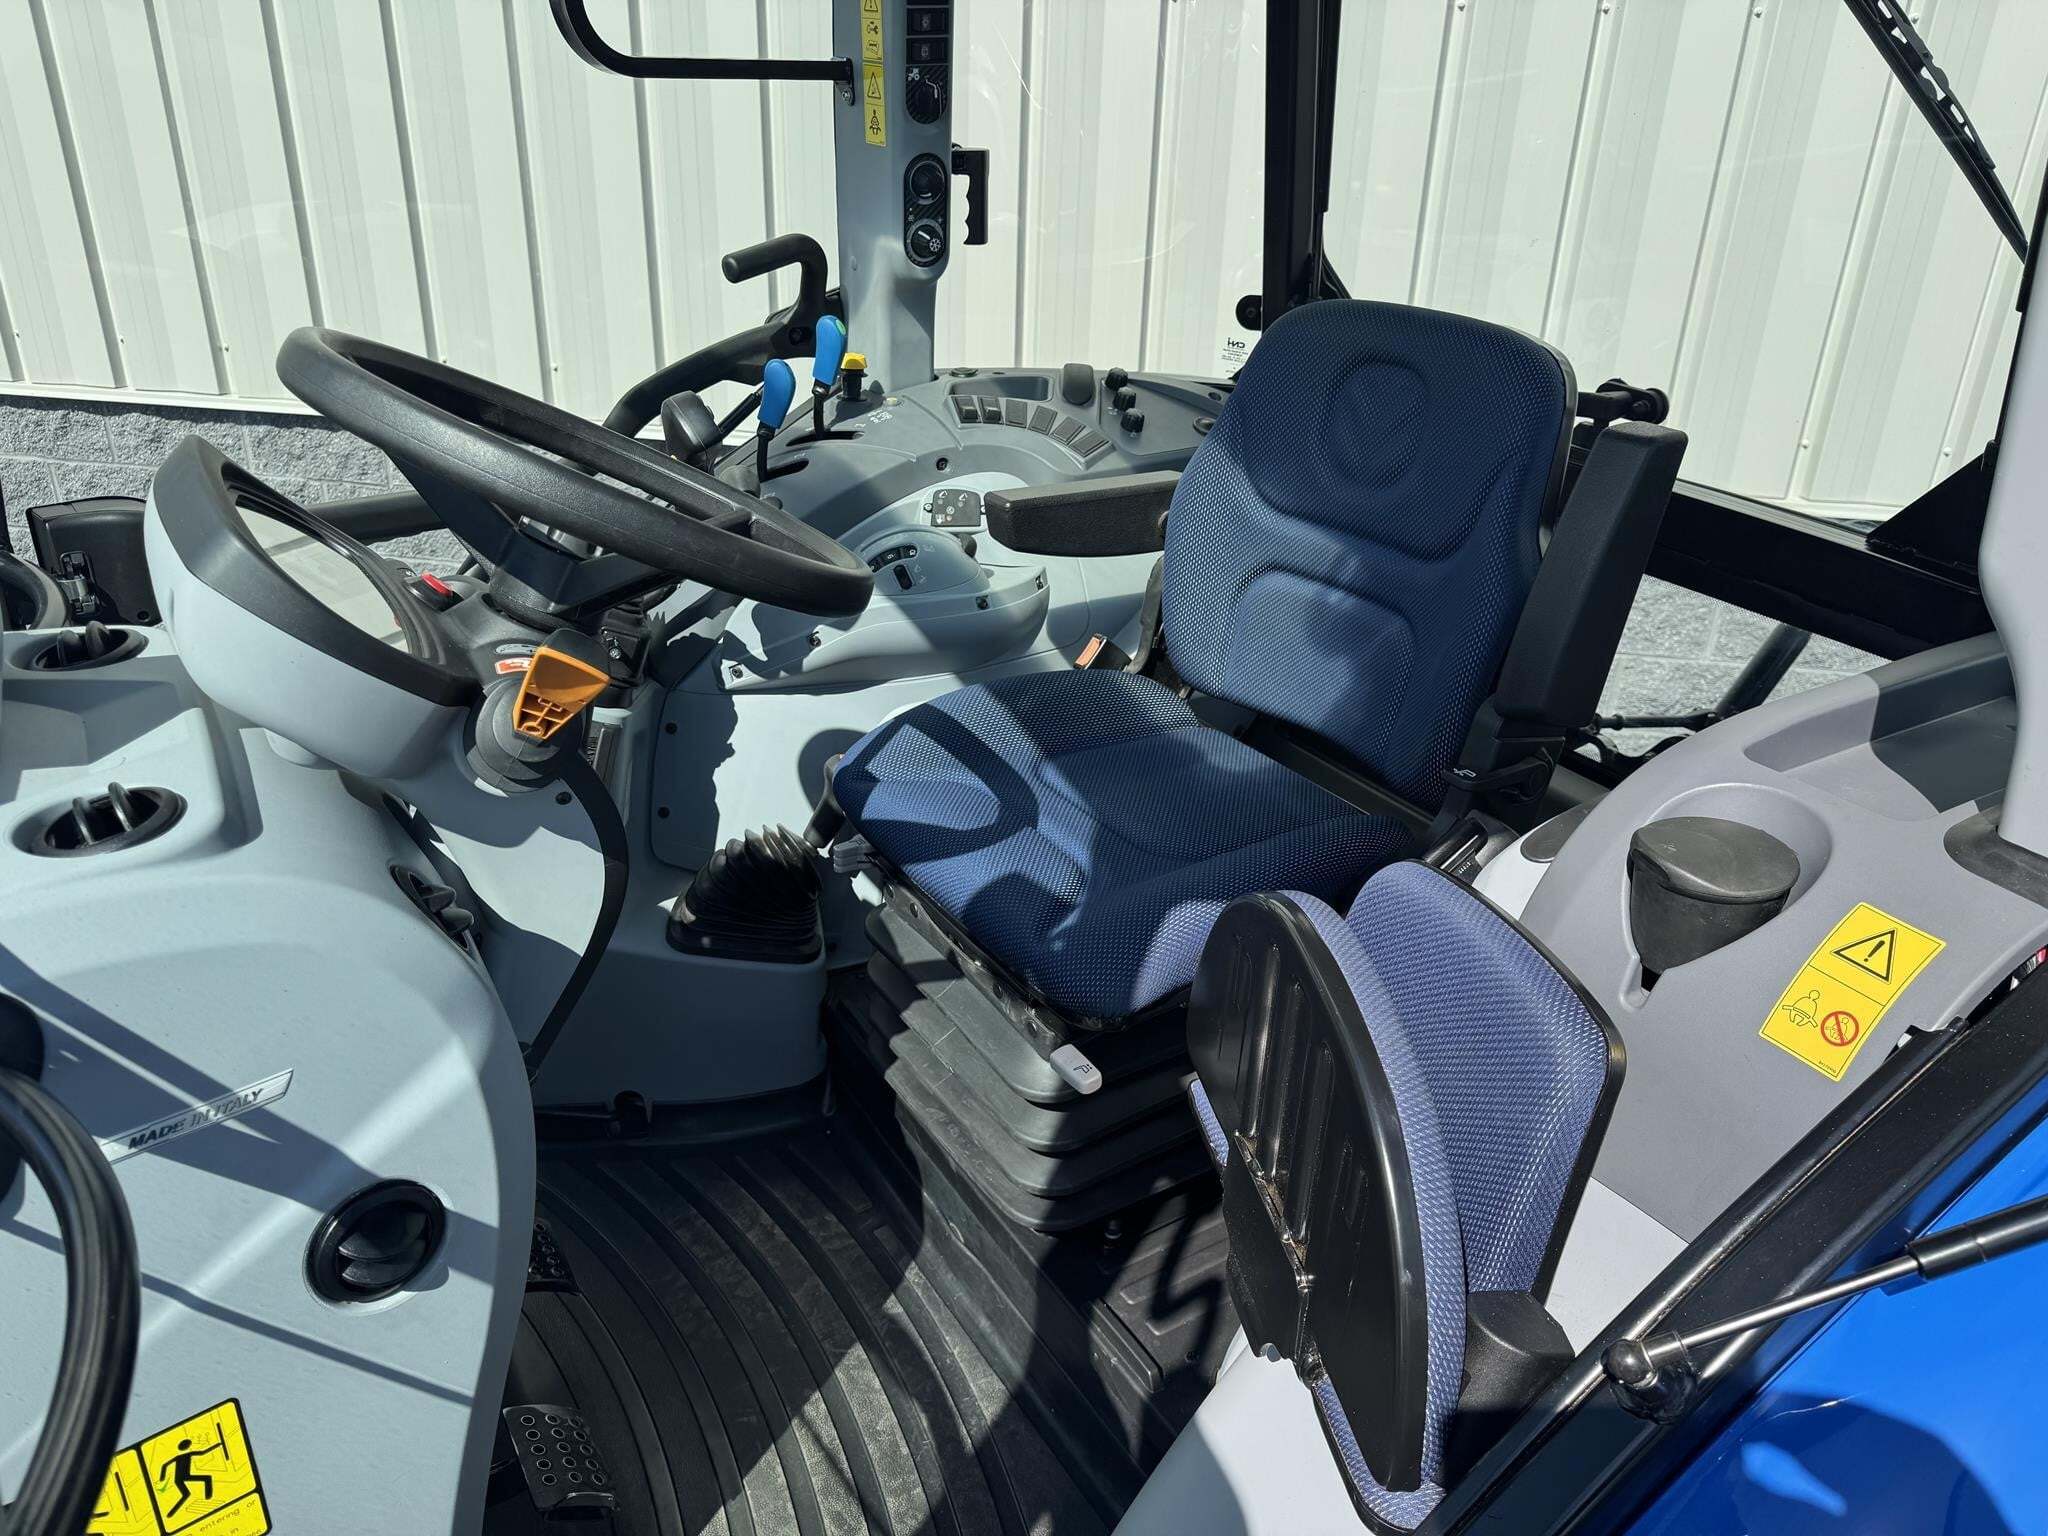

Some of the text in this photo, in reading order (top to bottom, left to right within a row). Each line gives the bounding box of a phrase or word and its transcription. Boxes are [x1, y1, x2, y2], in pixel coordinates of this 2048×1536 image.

[128, 1088, 263, 1150] MADE IN ITALY
[200, 1508, 240, 1532] entering
[246, 1500, 256, 1508] or
